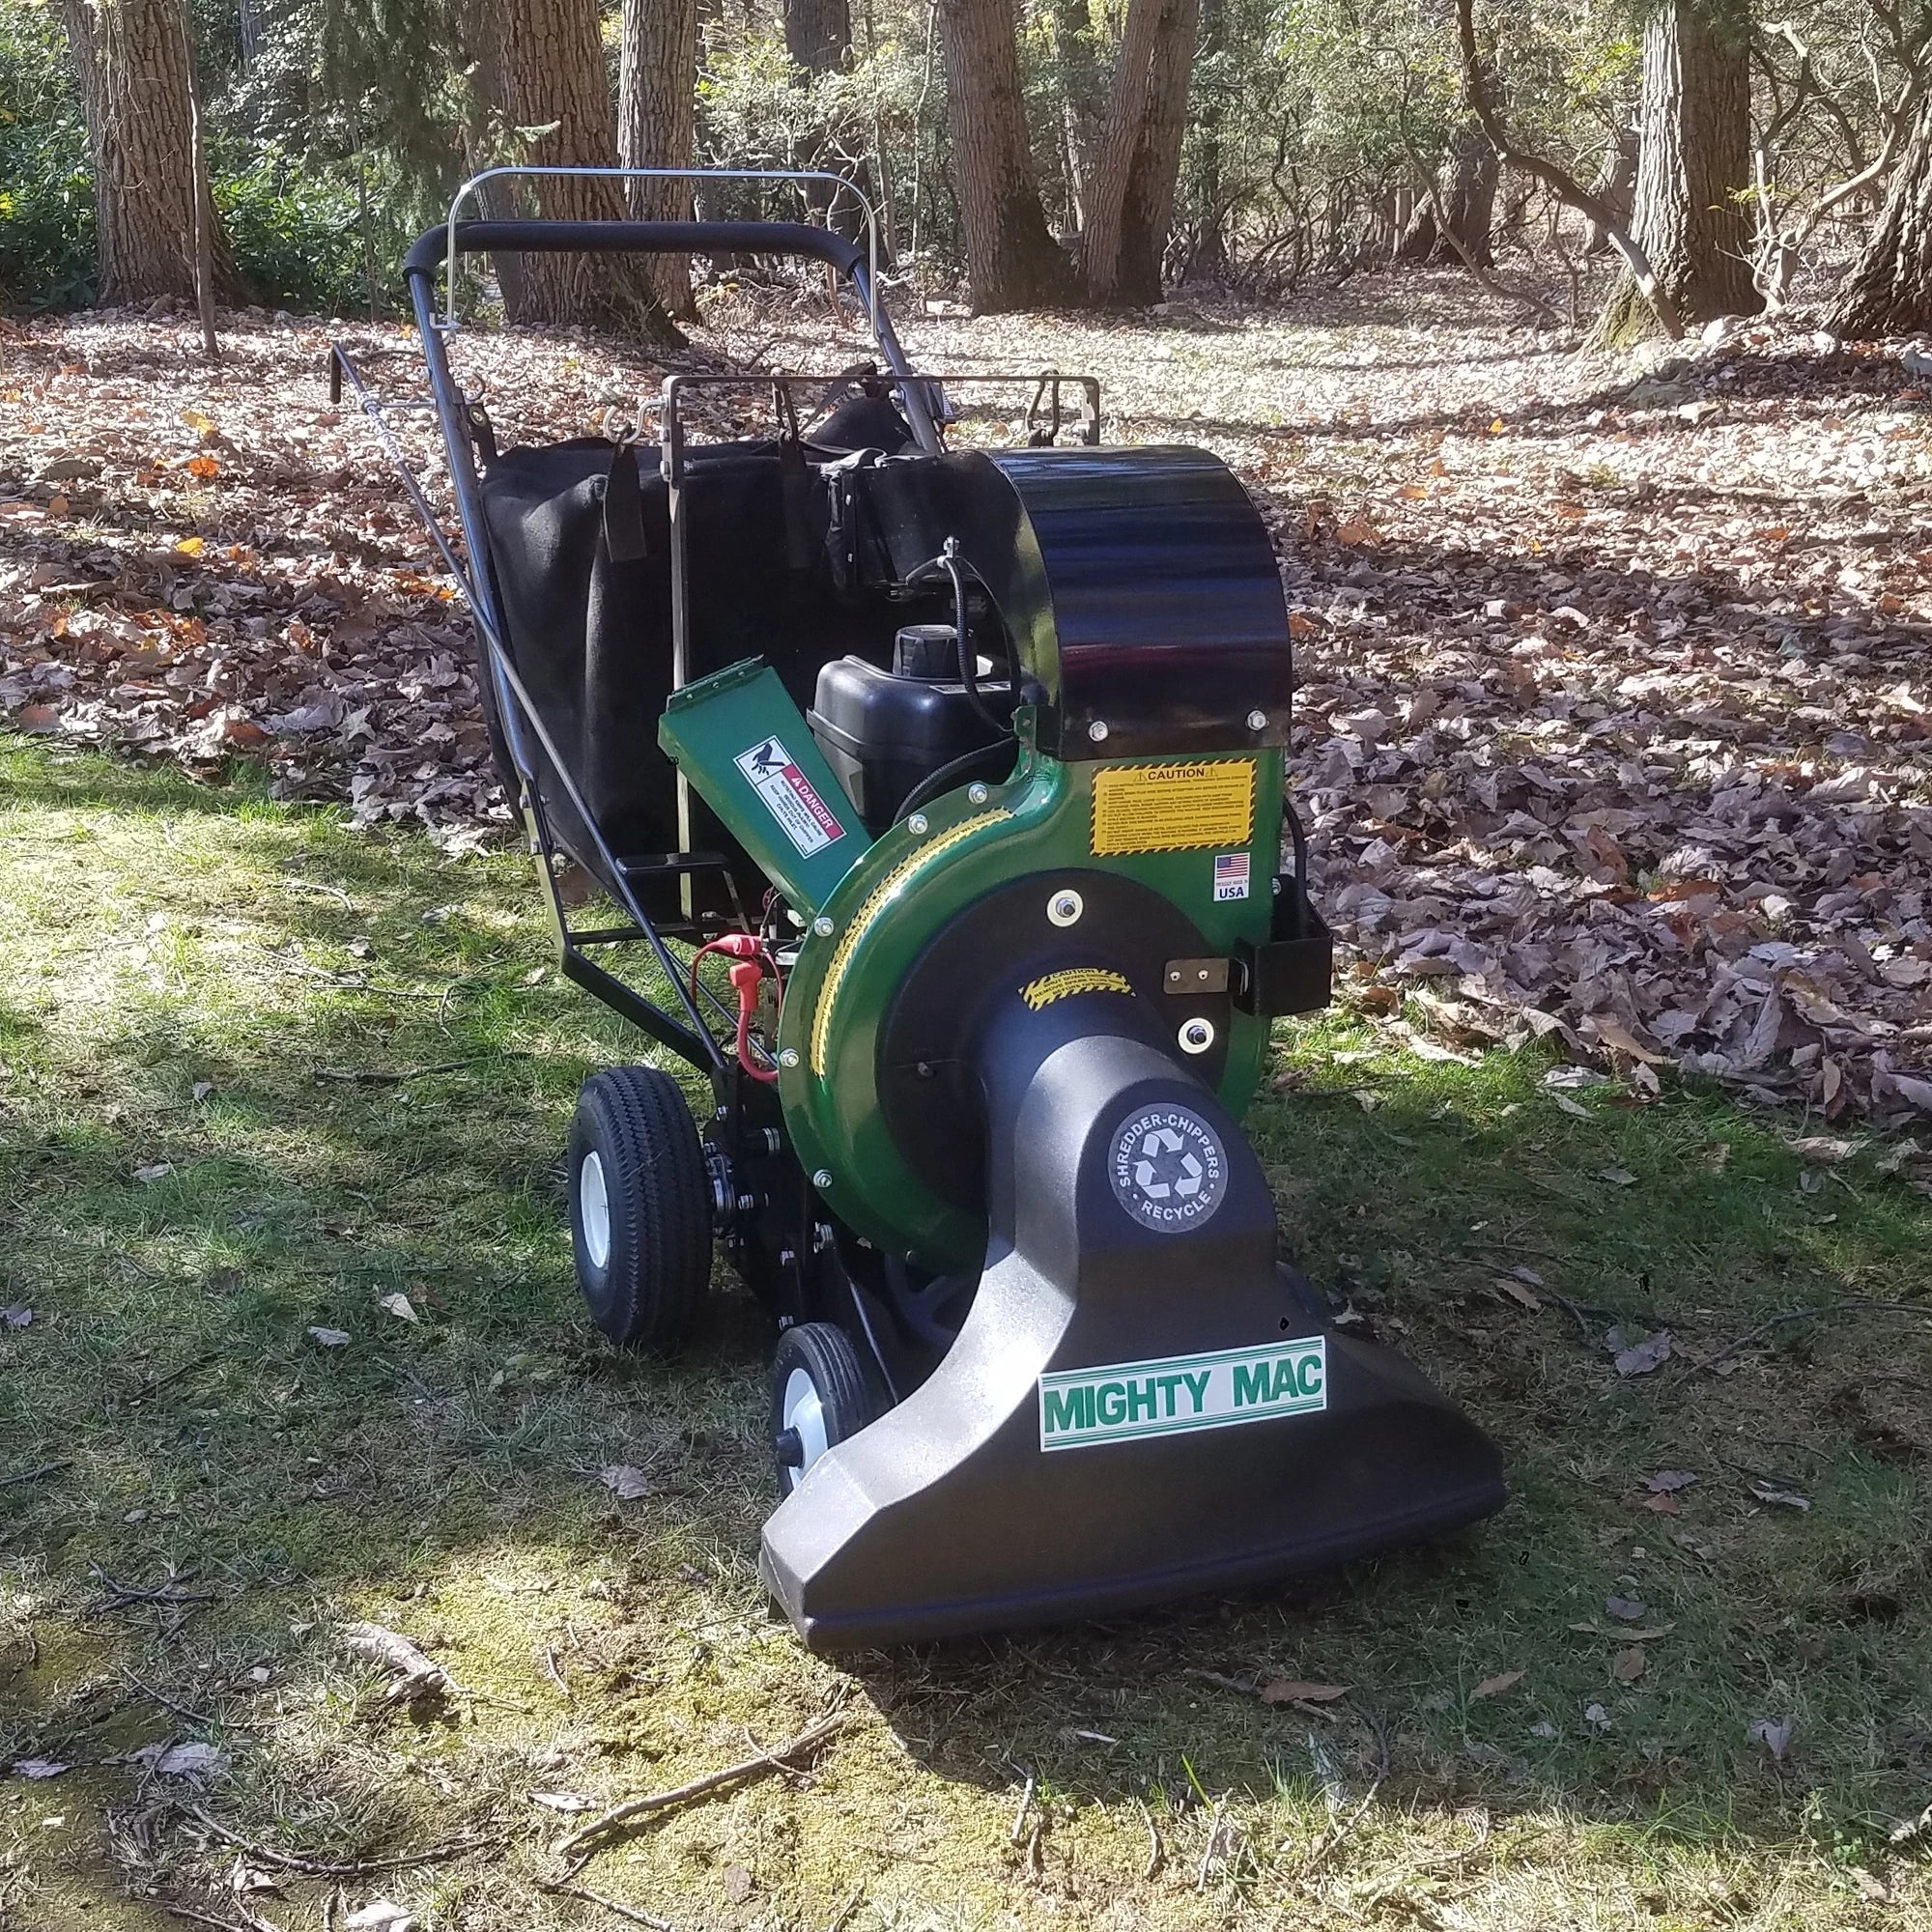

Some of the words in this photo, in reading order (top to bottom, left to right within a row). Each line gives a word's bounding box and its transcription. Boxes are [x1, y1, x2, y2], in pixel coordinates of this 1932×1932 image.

[1148, 768, 1205, 781] CAUTION
[798, 785, 834, 829] DANGER
[1219, 887, 1244, 898] USA
[1052, 969, 1095, 979] CAUTION
[1117, 1114, 1220, 1187] SHREDDER-CHIPPERS
[1141, 1190, 1211, 1220] RECYCLE
[1044, 1371, 1211, 1434] MIGHTY
[1233, 1354, 1322, 1407] MAC
